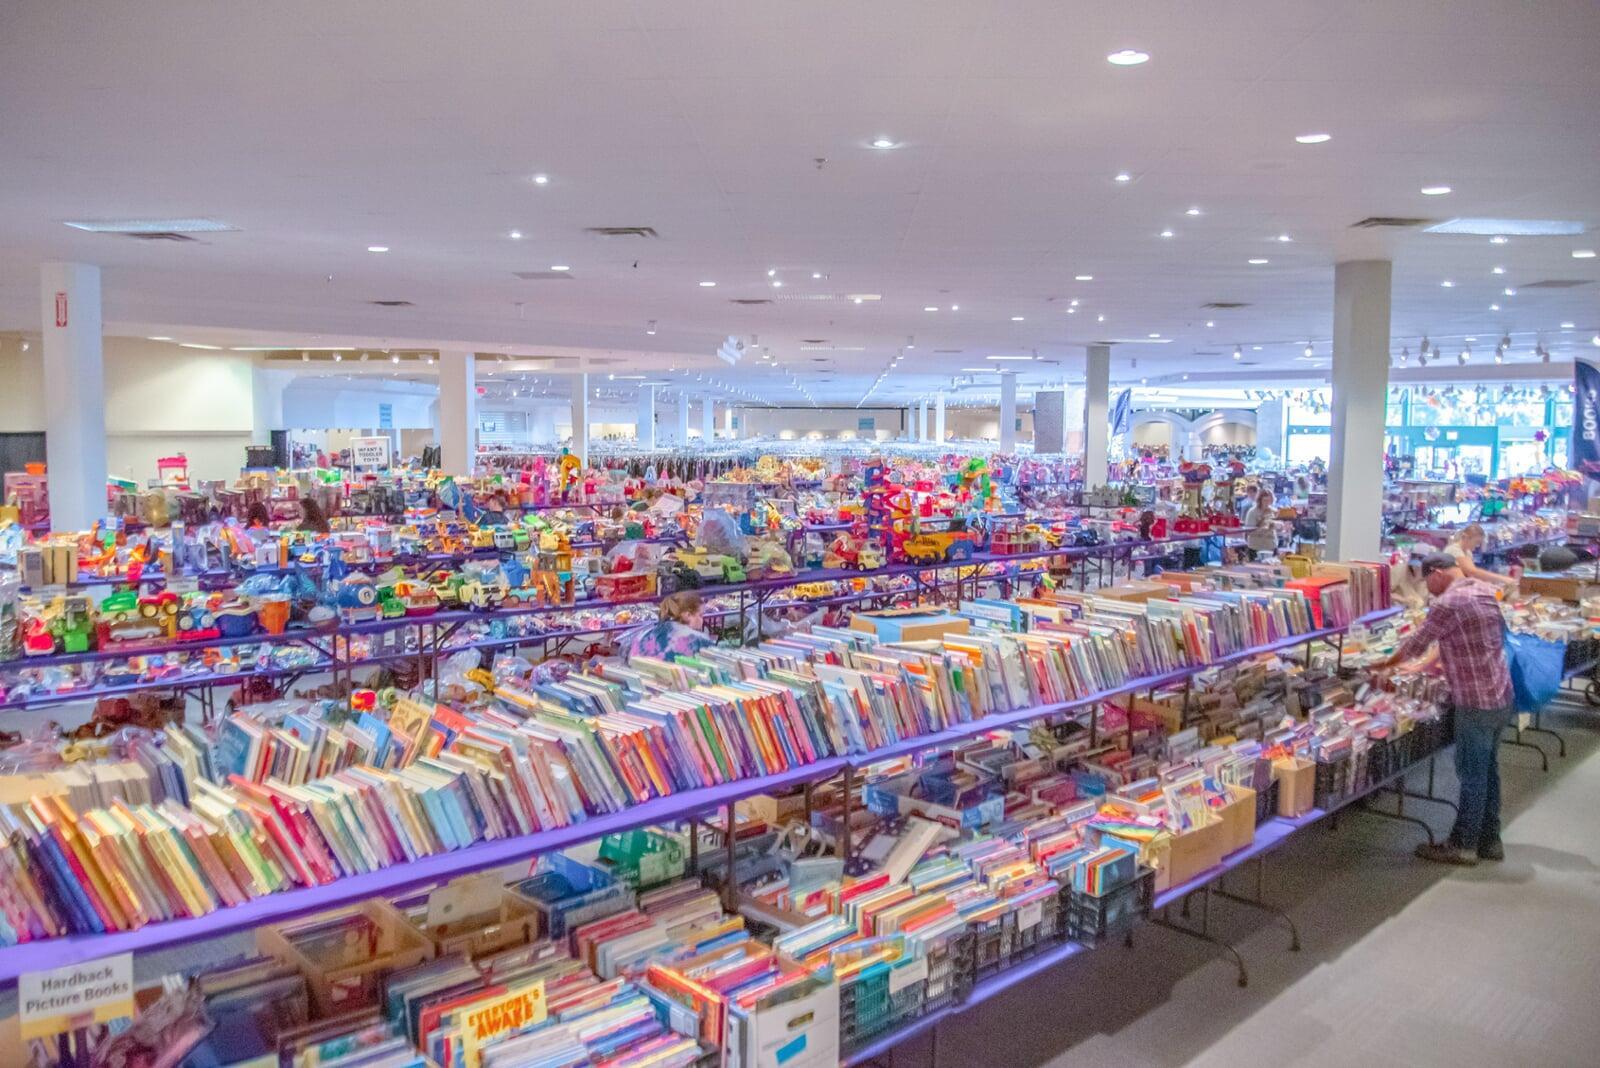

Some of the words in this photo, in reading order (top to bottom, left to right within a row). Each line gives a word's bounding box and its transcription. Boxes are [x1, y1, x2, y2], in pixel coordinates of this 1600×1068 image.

[26, 993, 80, 1013] Picture
[84, 981, 129, 1000] Books
[41, 967, 113, 992] Hardback
[468, 989, 540, 1027] EVERYONE'S
[476, 1002, 534, 1040] AWAKE
